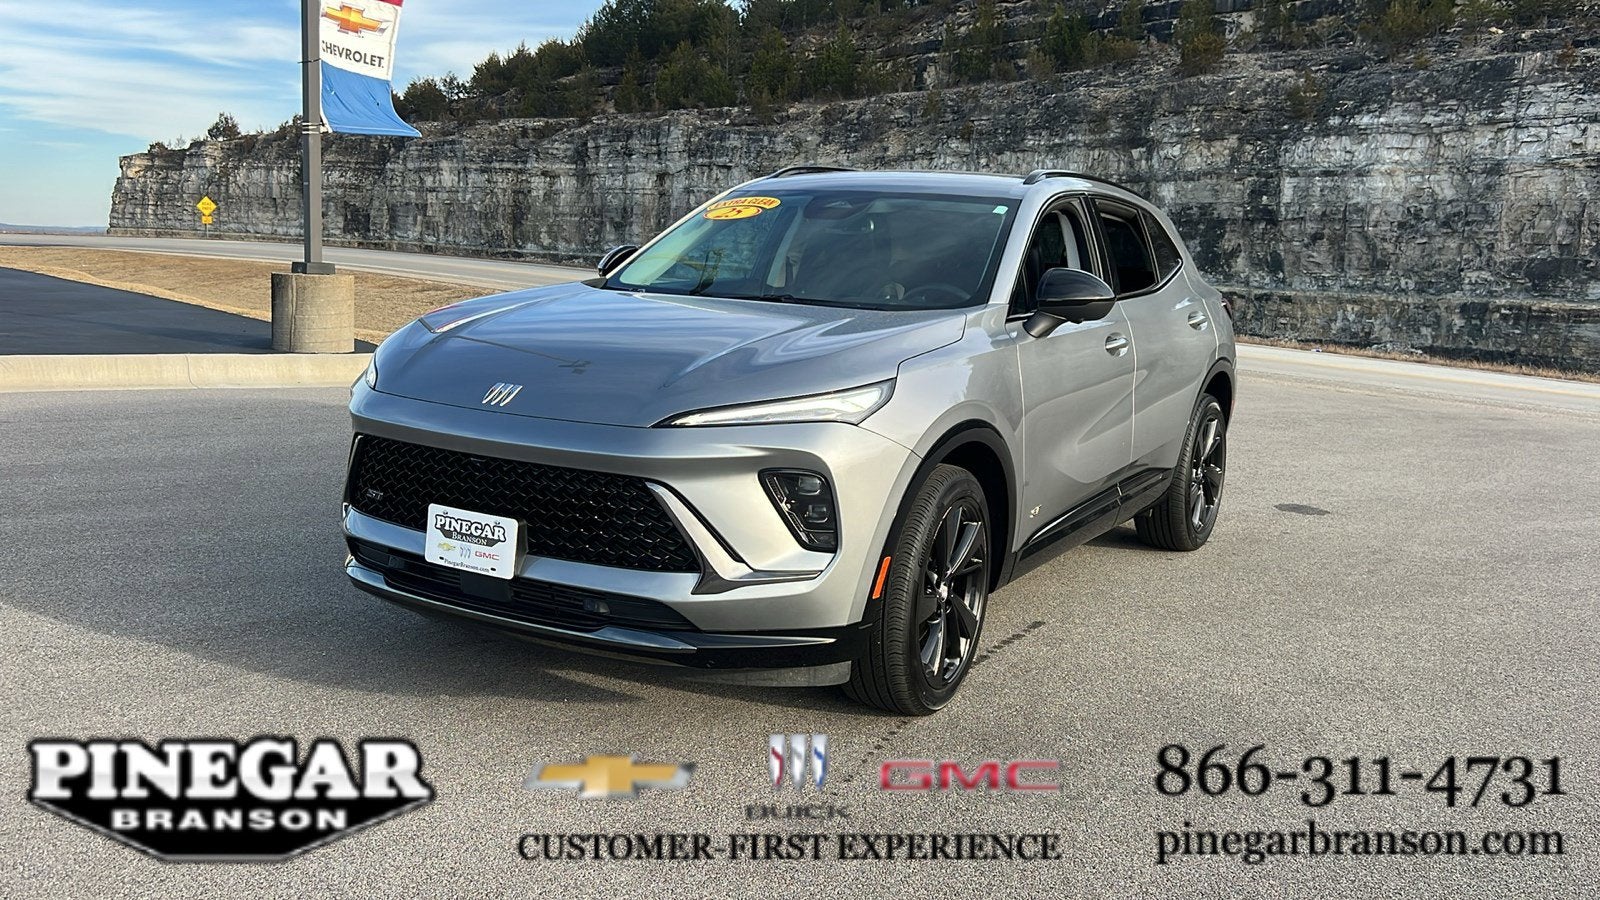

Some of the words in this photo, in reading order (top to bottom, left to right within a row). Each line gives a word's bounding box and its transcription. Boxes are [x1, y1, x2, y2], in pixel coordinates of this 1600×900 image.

[435, 514, 506, 542] PINEGAR
[452, 531, 487, 546] BRANSON
[474, 550, 500, 561] GMC
